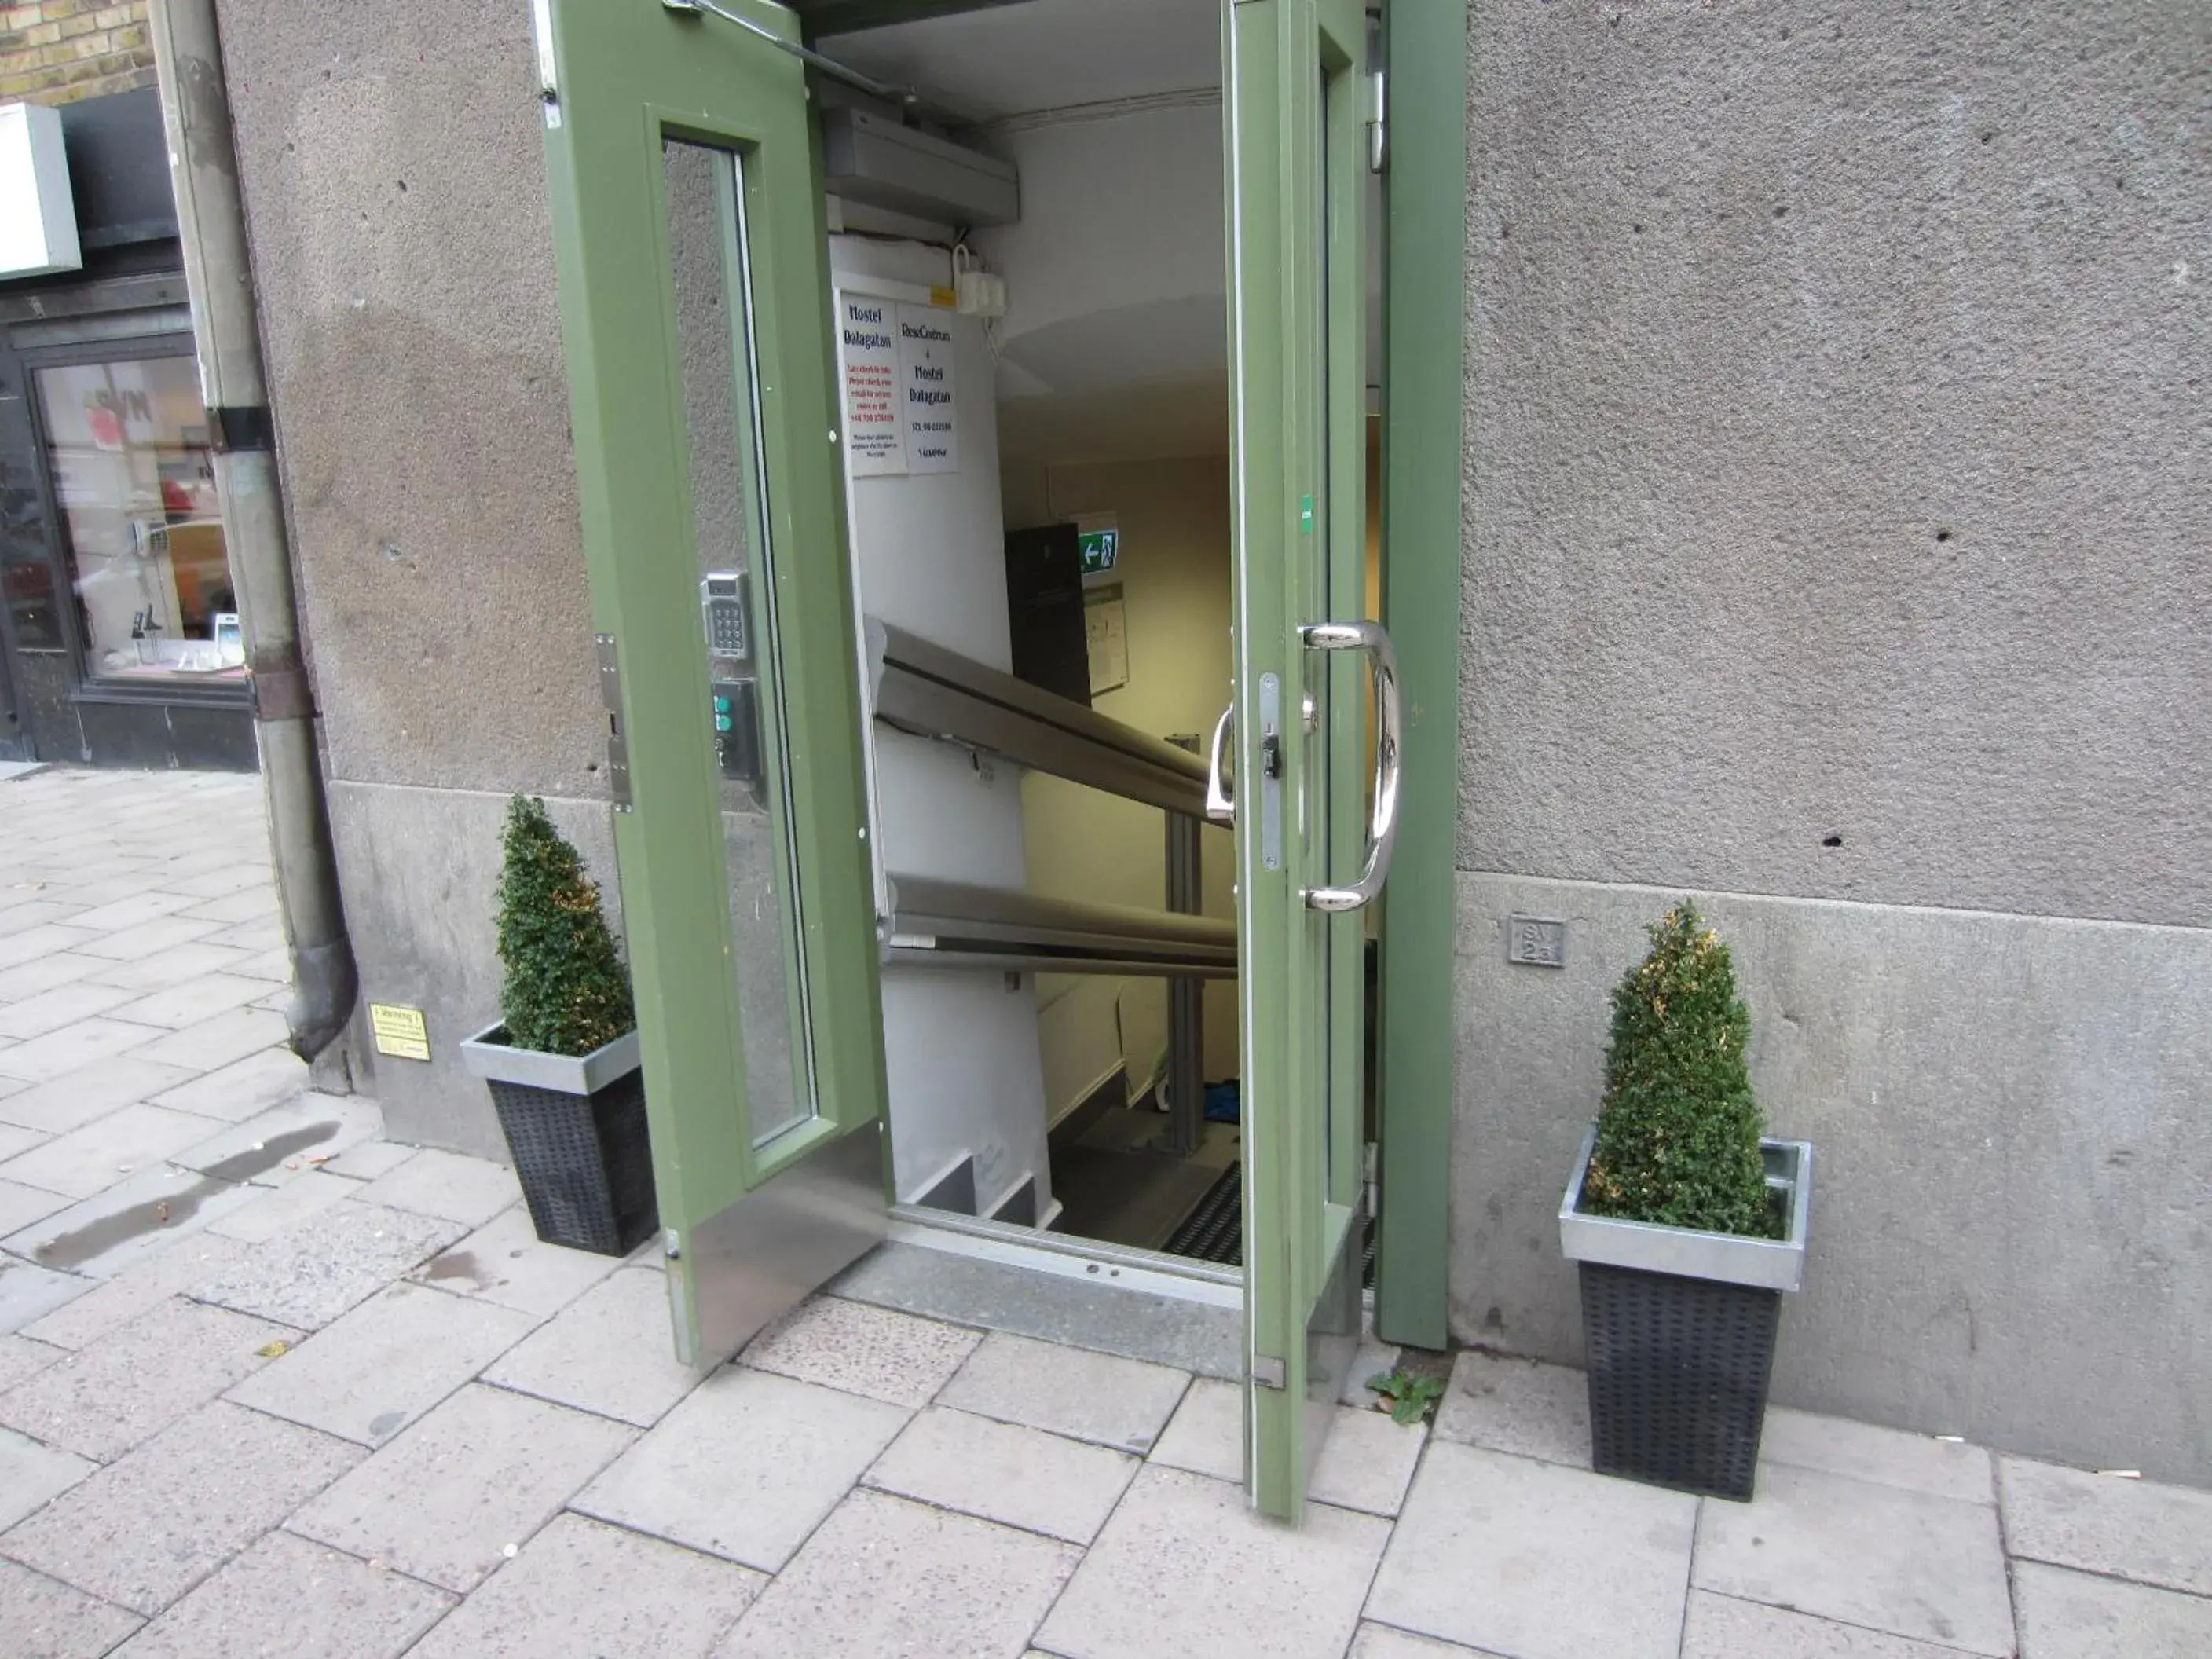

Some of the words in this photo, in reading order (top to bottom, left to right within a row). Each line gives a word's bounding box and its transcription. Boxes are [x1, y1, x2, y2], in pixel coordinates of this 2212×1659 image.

[849, 304, 881, 324] Hostel
[844, 329, 892, 350] Dalagatan
[915, 365, 943, 380] Hostel
[910, 388, 950, 405] Dalagatan
